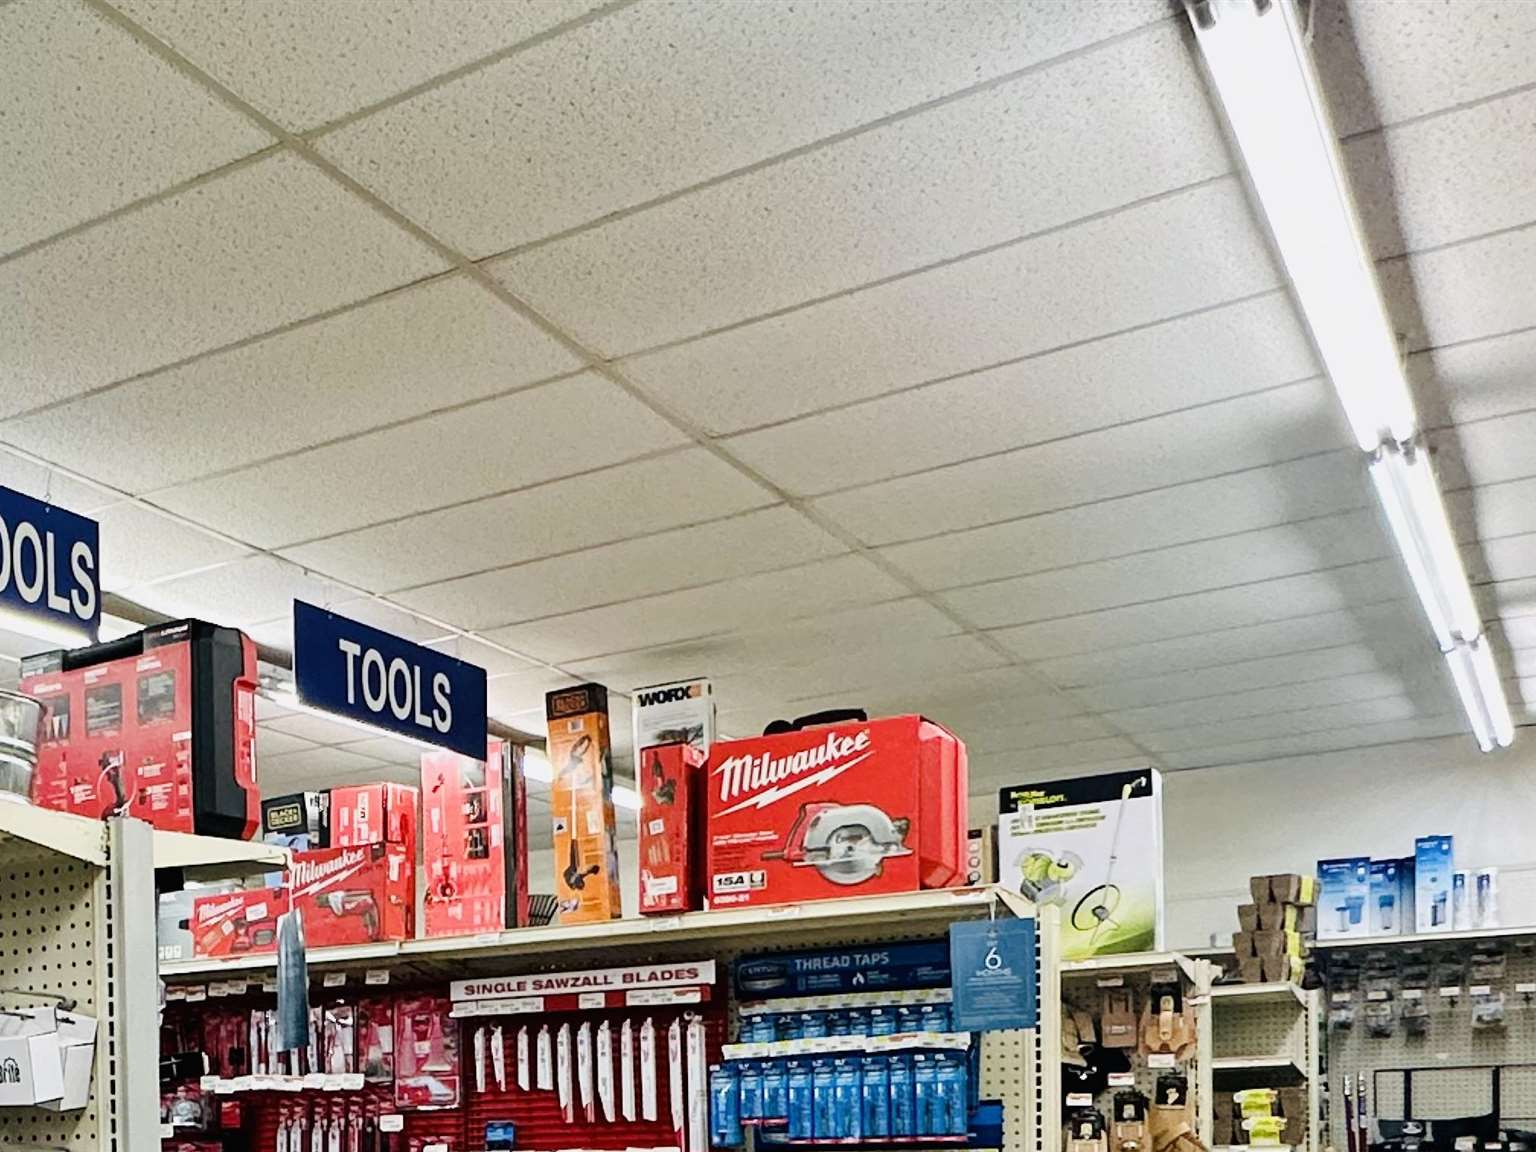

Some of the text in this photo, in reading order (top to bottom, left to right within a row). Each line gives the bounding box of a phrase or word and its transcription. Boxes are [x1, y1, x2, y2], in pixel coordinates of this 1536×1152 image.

[339, 639, 453, 733] TOOLS
[638, 686, 693, 707] WORX
[711, 730, 872, 802] Milwaukee
[291, 848, 365, 886] Milwaukee
[795, 956, 850, 971] THREAD
[856, 952, 890, 966] TAPS
[985, 947, 1002, 970] 6
[464, 967, 700, 996] SINGLE SAWZALL BLADES
